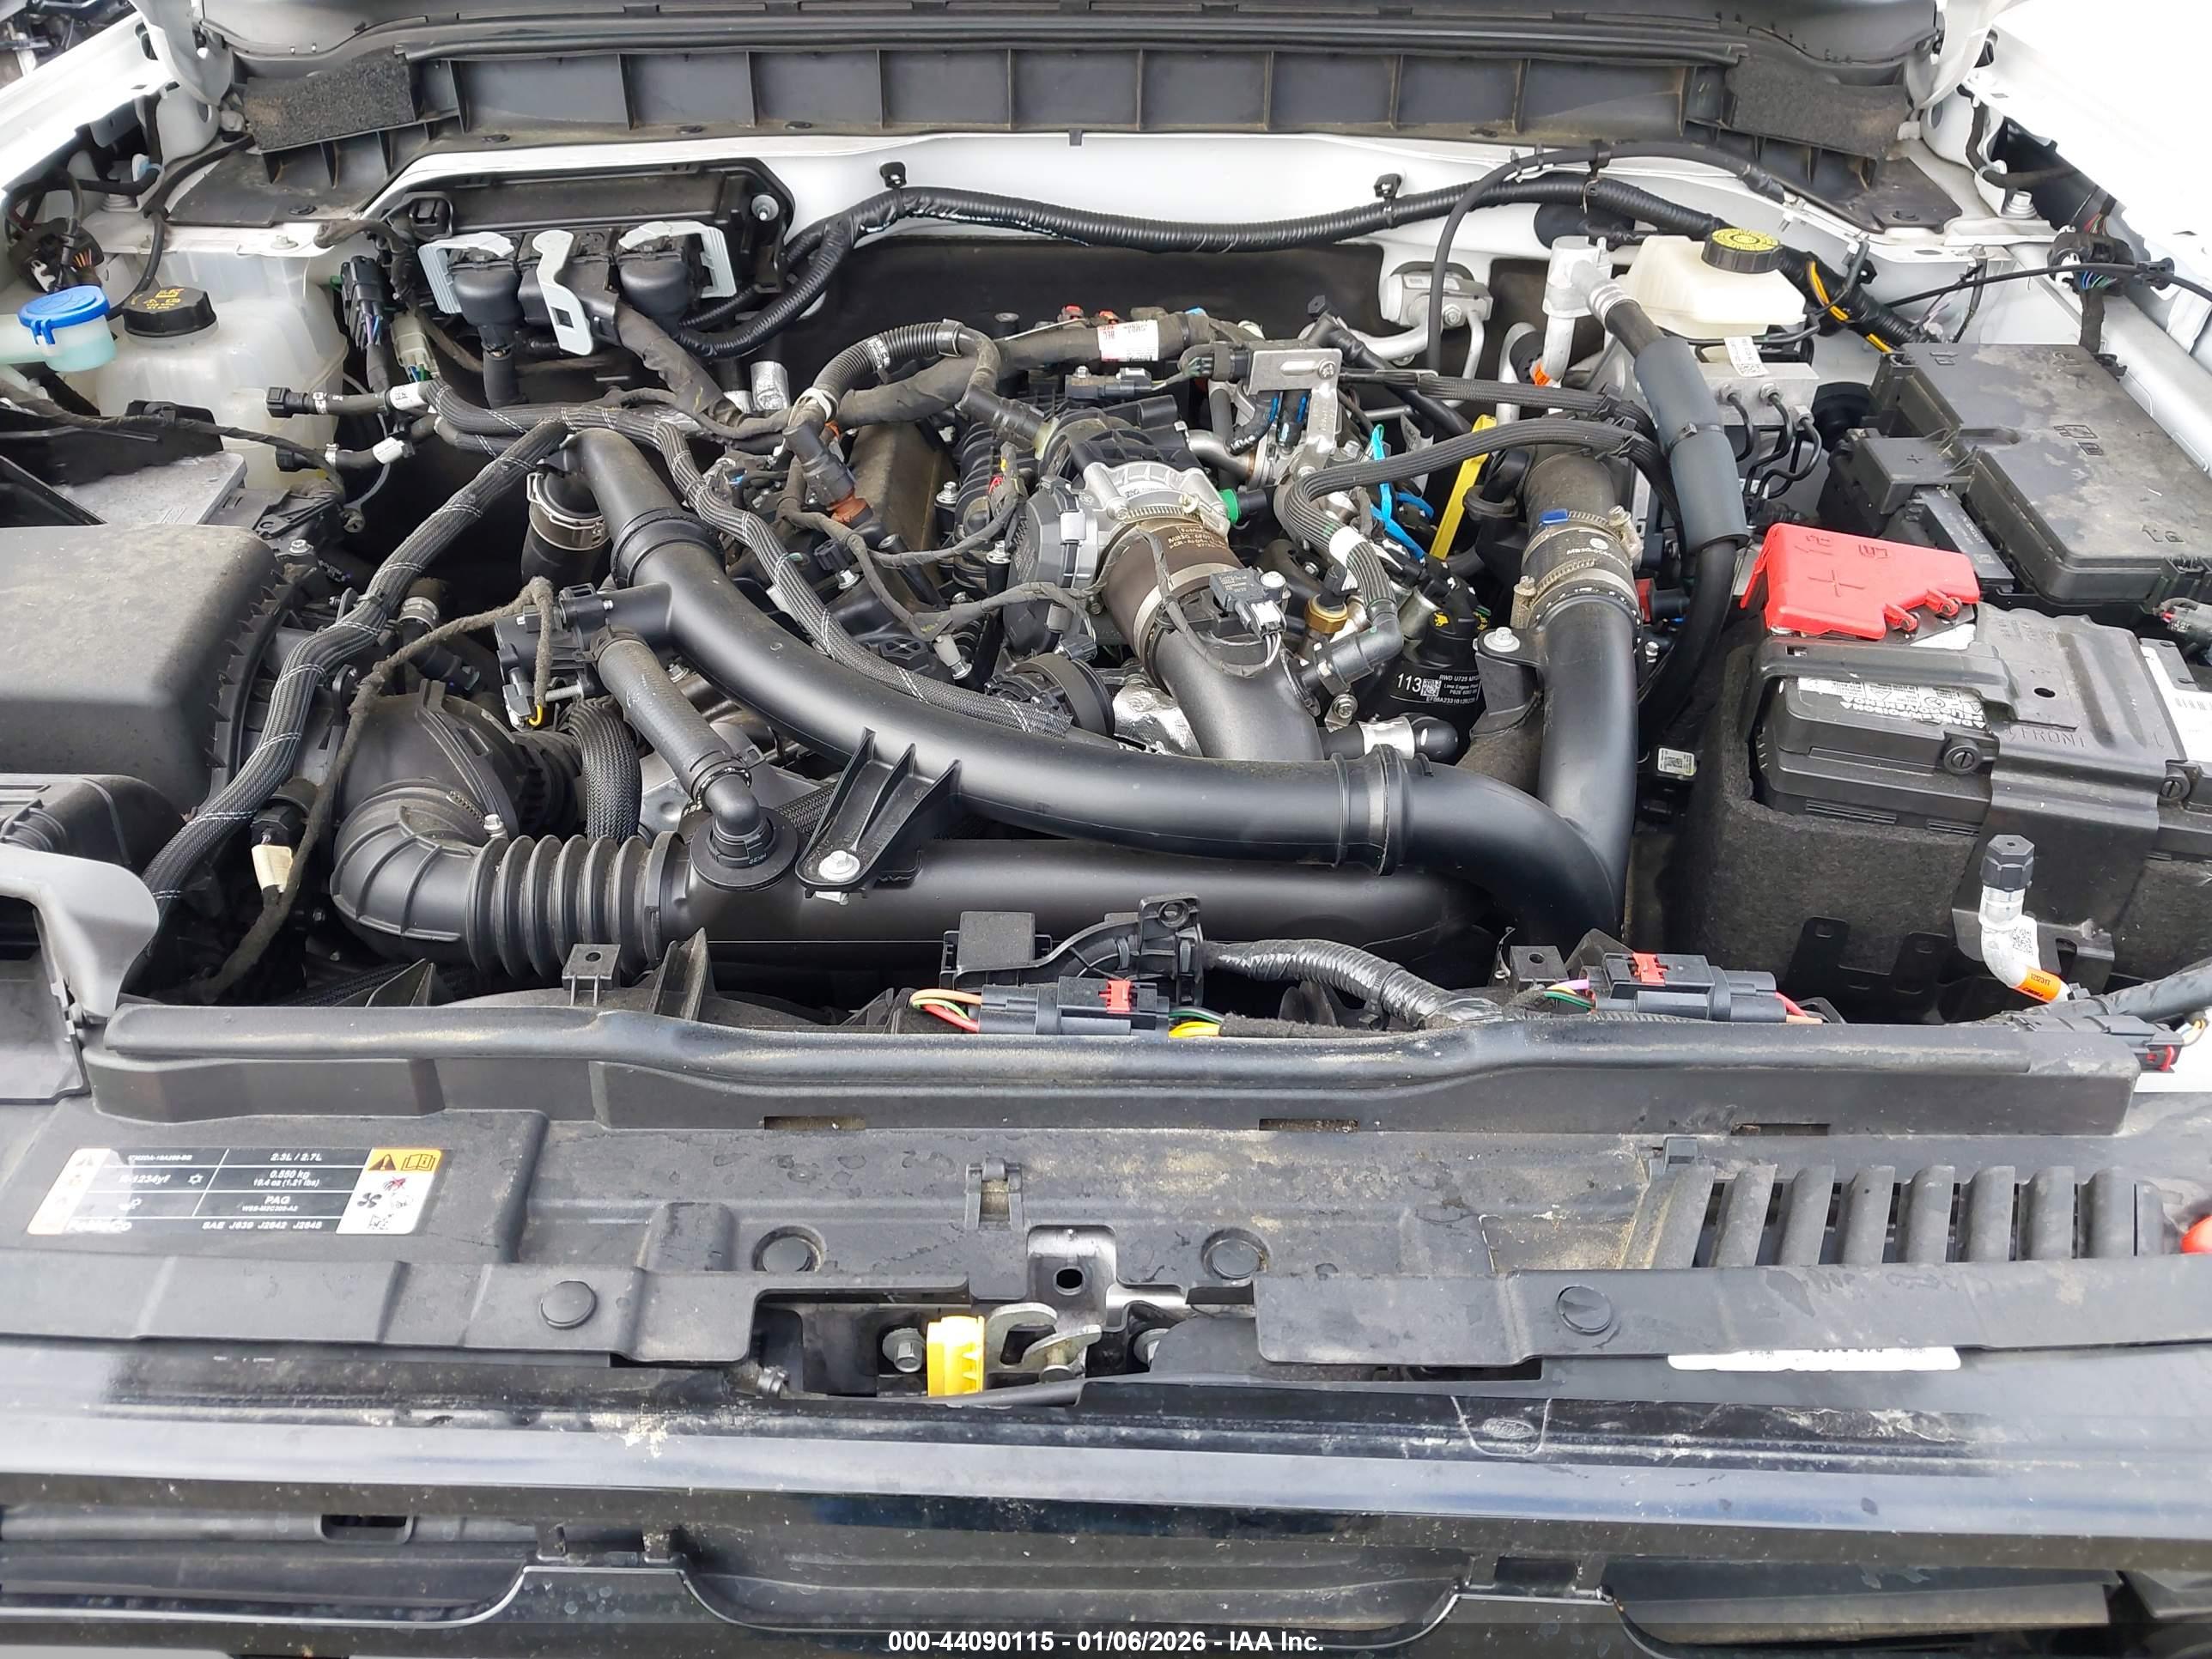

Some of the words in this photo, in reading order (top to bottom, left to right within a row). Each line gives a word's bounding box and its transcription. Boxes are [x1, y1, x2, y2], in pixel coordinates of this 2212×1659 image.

[1397, 672, 1422, 692] 113
[270, 1170, 296, 1179] 0.550
[297, 1170, 310, 1180] kg
[264, 1195, 291, 1204] PAG
